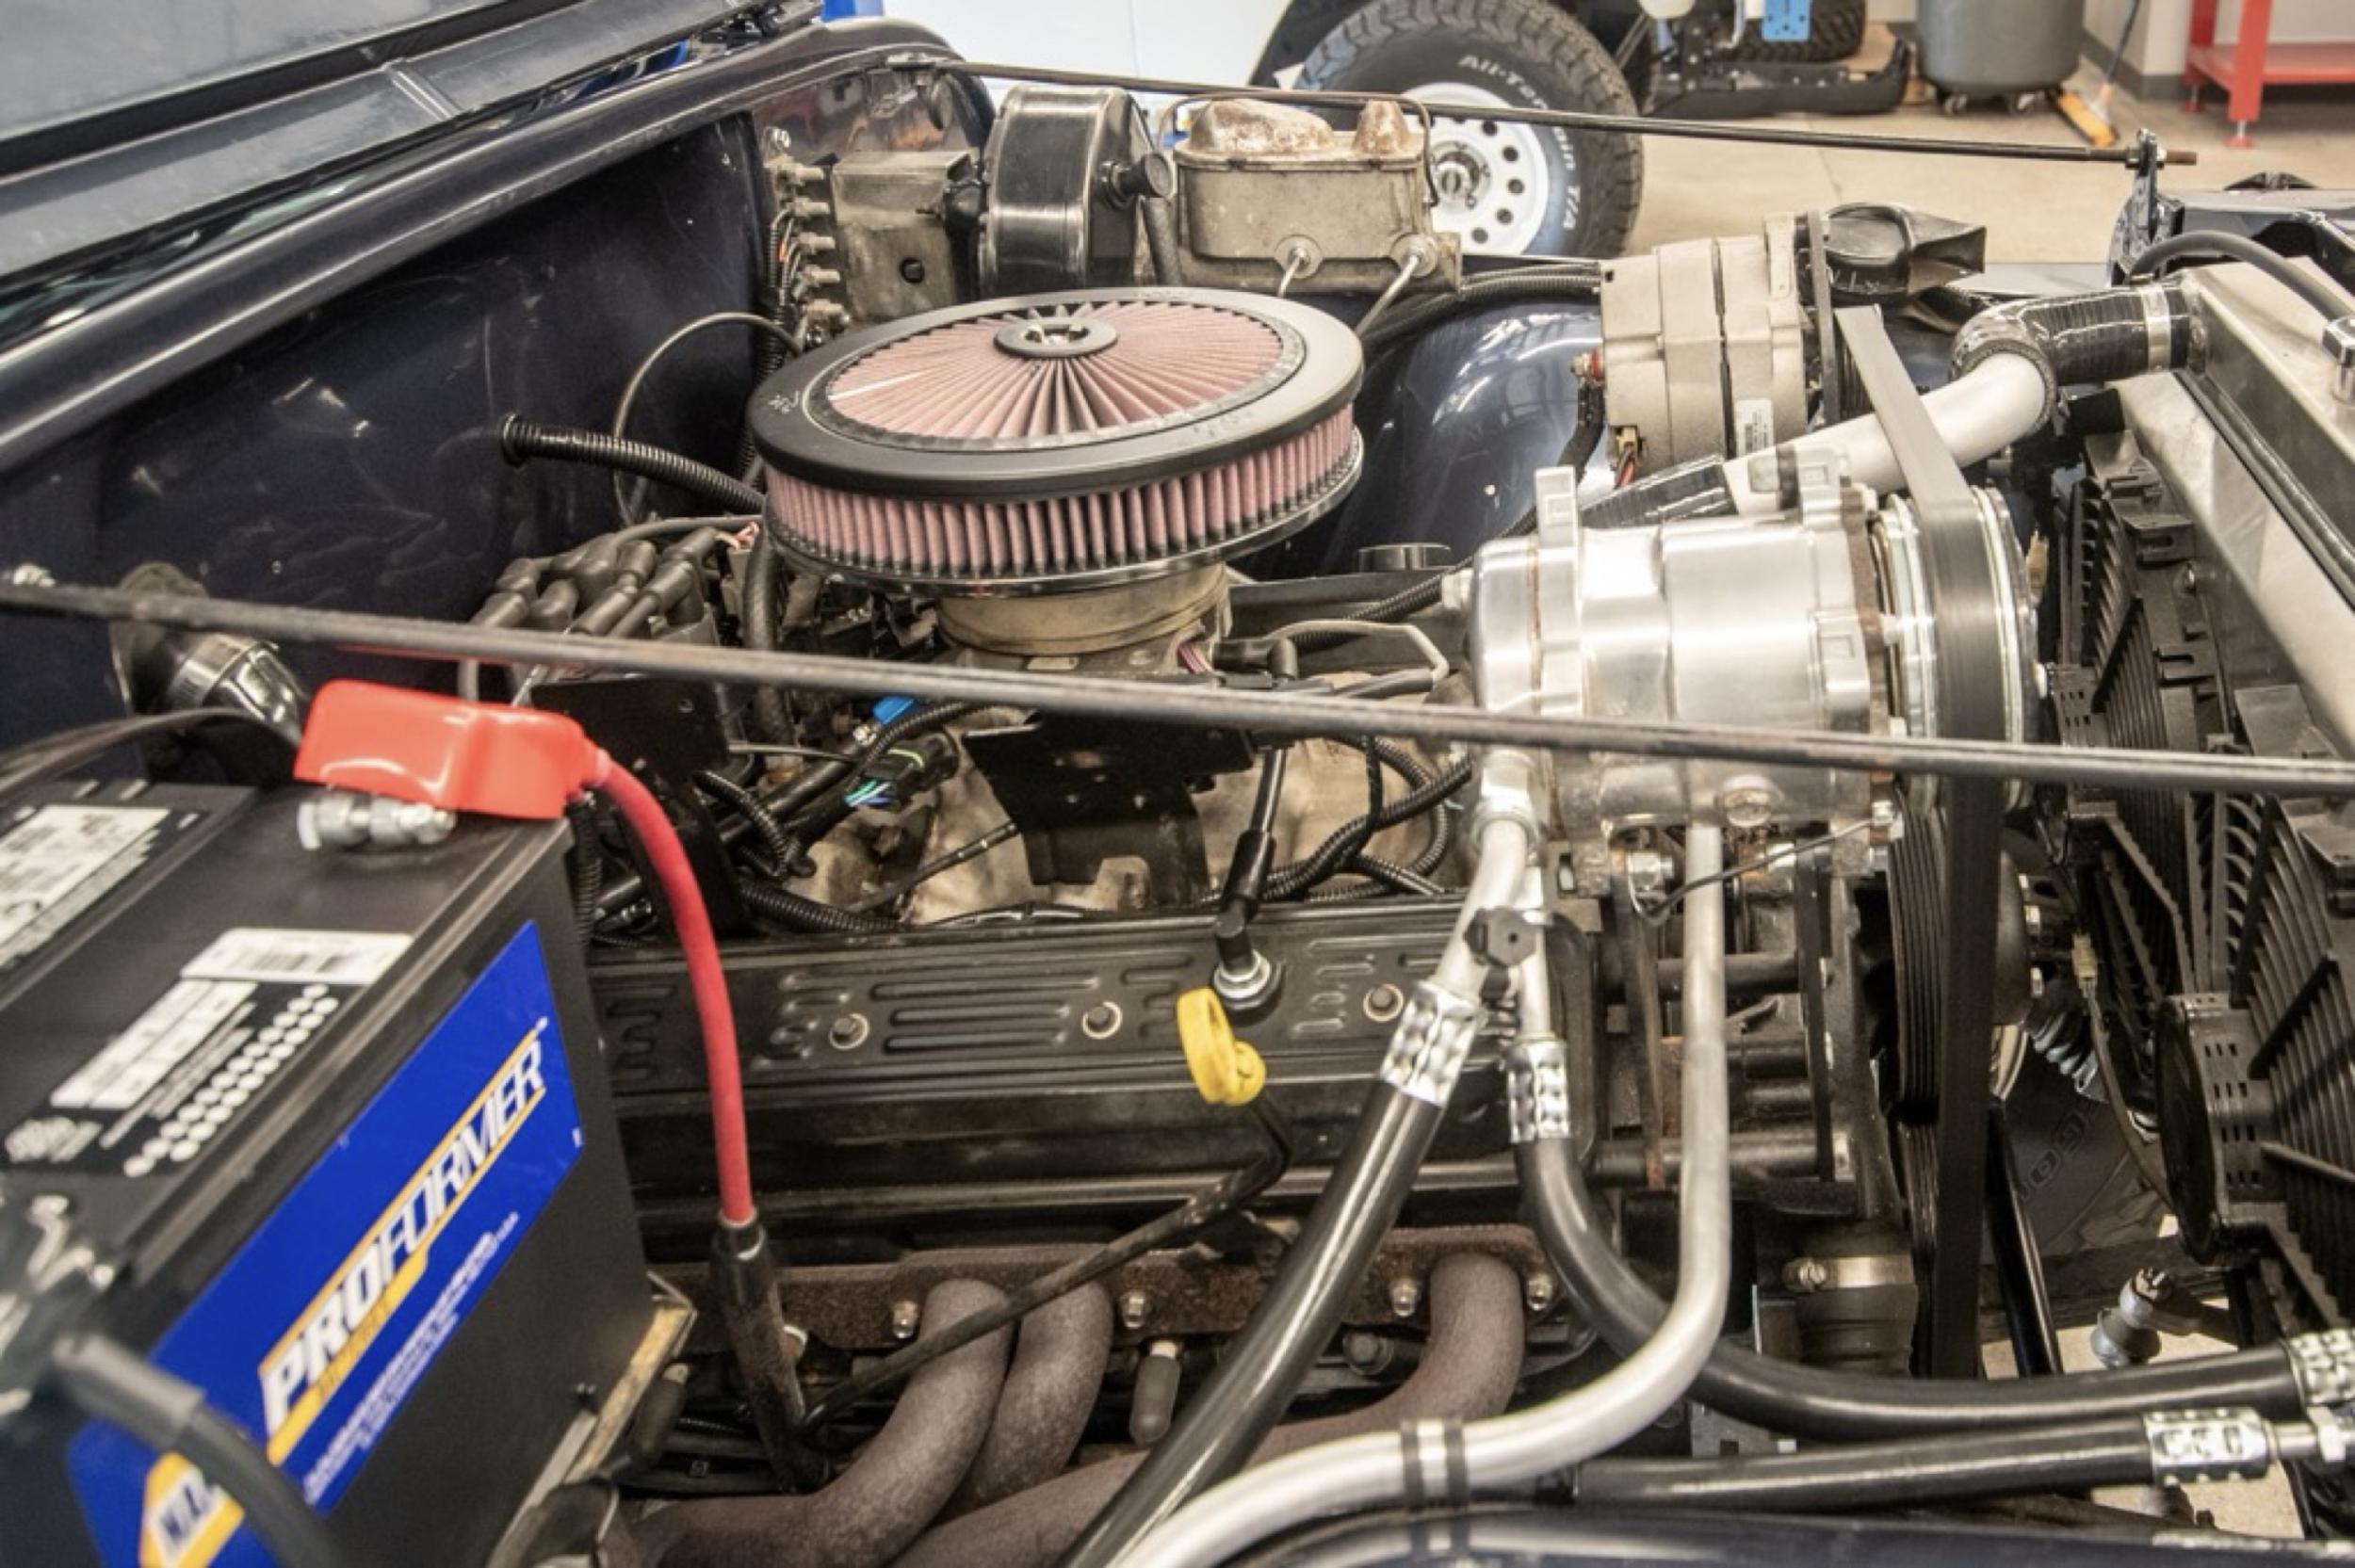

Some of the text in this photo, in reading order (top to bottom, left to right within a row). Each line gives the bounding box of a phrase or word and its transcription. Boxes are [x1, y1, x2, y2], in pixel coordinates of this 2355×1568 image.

[1458, 54, 1582, 230] All-Terain T/A
[260, 1038, 545, 1439] PROFORMER
